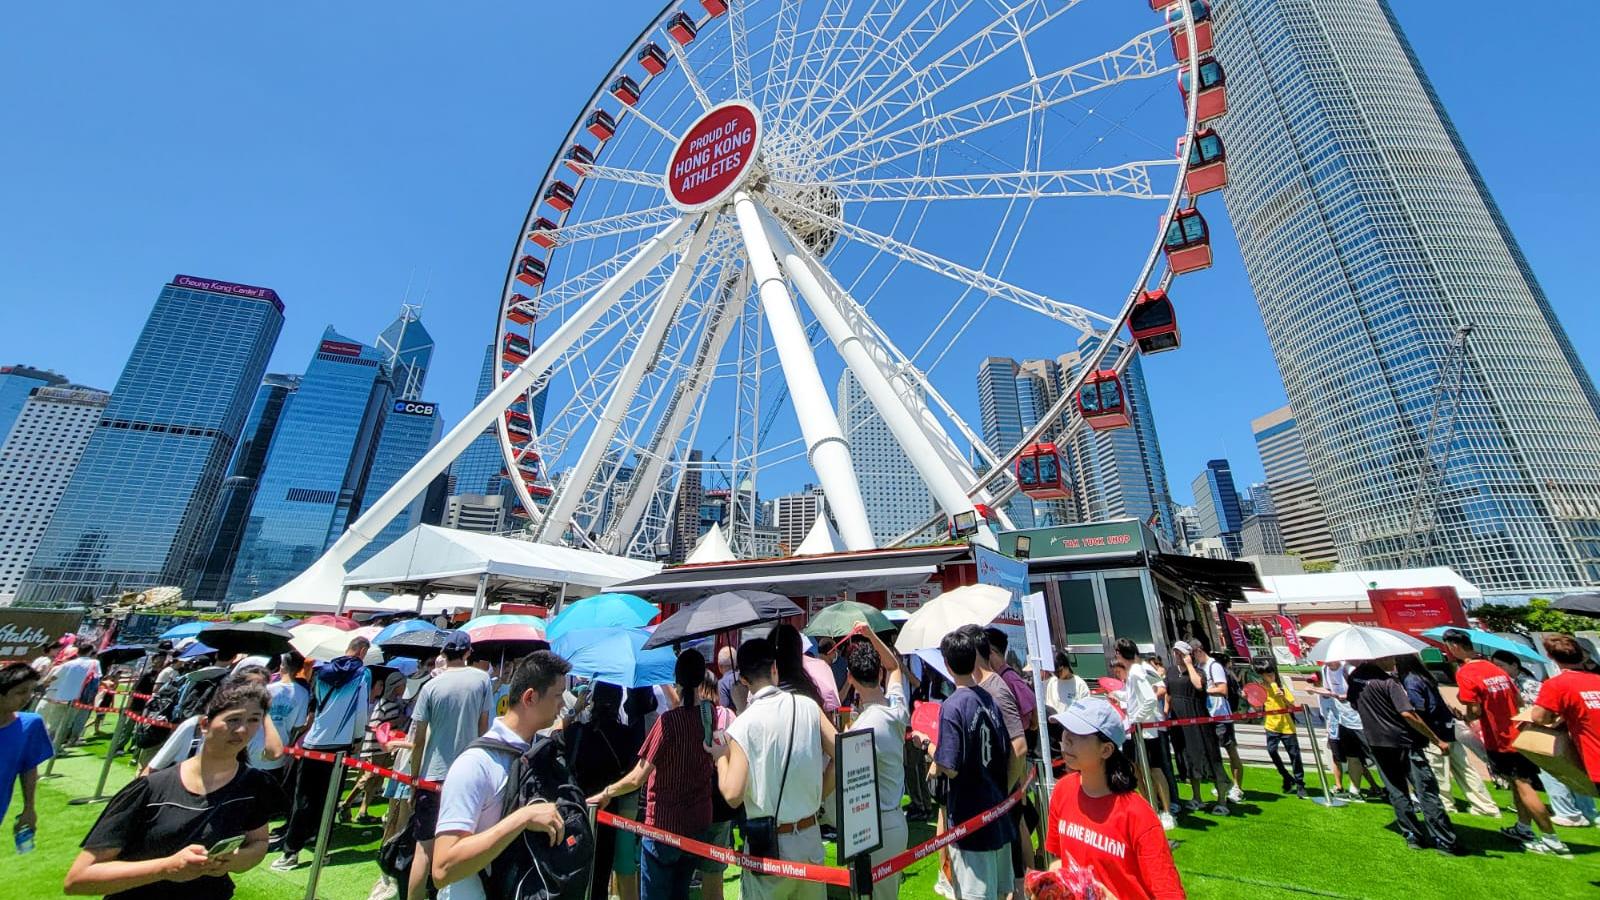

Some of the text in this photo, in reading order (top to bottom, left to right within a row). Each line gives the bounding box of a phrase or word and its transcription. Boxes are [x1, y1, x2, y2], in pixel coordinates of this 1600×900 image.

[689, 118, 739, 154] PROUD OF
[674, 127, 752, 179] HONG KONG
[680, 151, 741, 193] ATHLETES
[210, 282, 231, 293] Kong
[232, 286, 258, 297] Center
[405, 403, 434, 415] CCB
[709, 847, 806, 877] Hong Kong Observation Wheel
